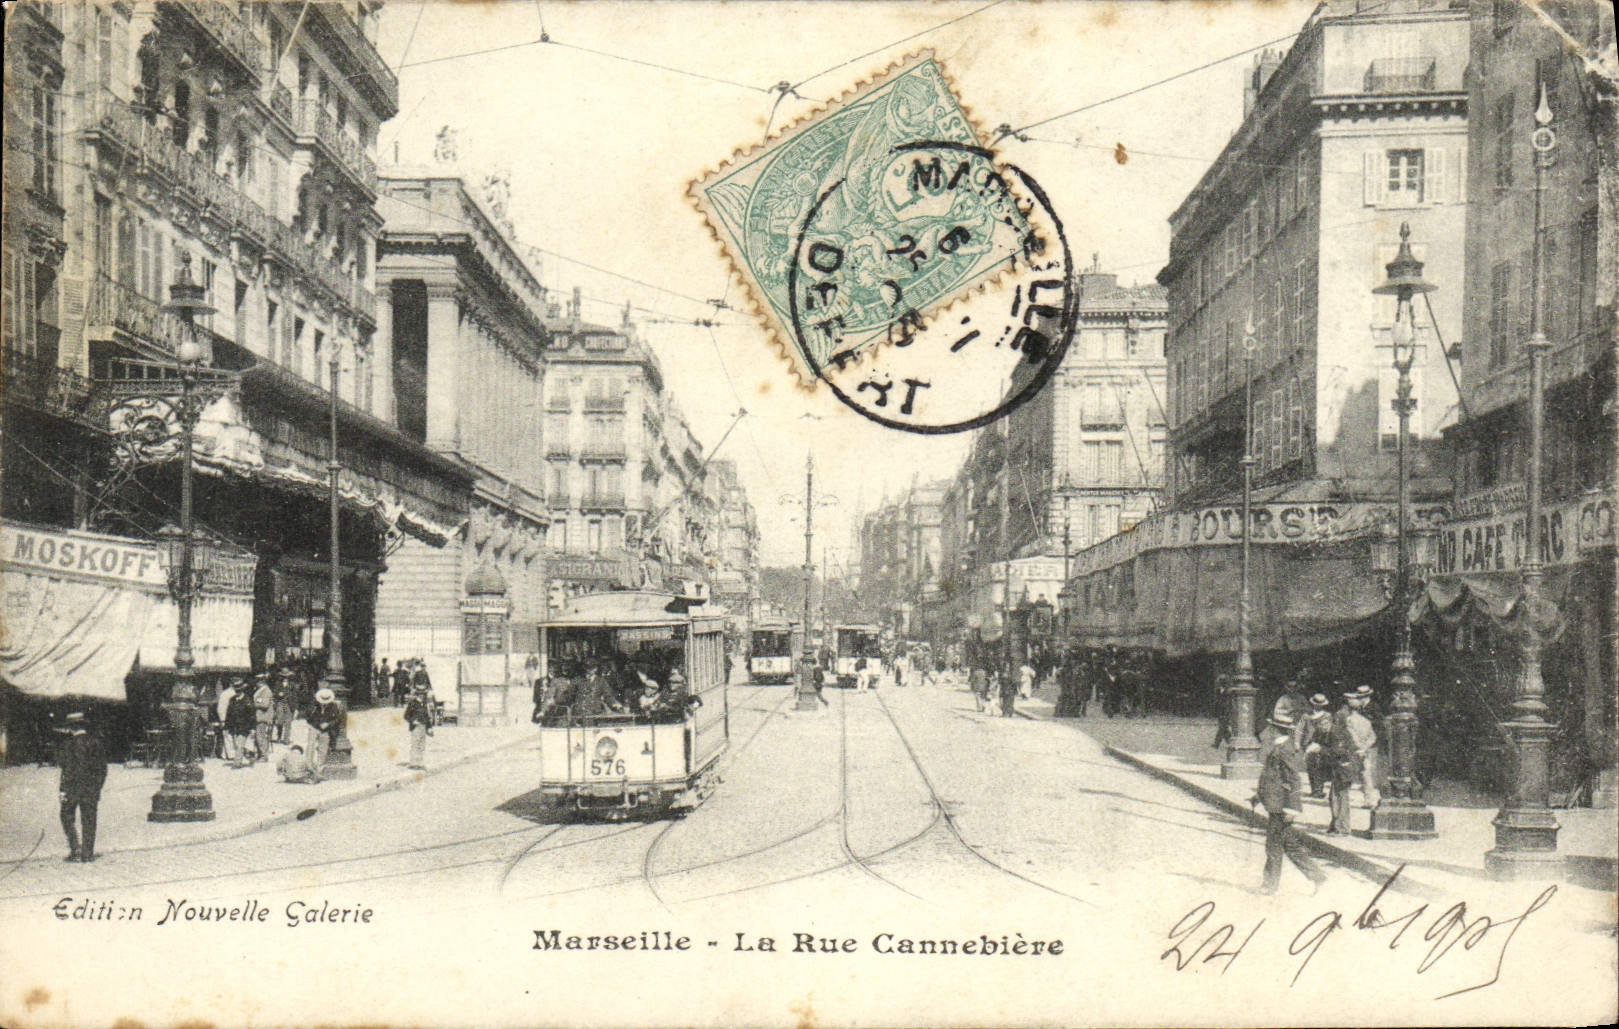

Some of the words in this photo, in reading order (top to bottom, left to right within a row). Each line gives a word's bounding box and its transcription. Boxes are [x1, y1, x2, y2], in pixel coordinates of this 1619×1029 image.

[911, 155, 1063, 364] MAREILLE
[14, 533, 157, 578] MOSKOFF
[1511, 510, 1564, 568] TRC
[591, 758, 626, 776] 576
